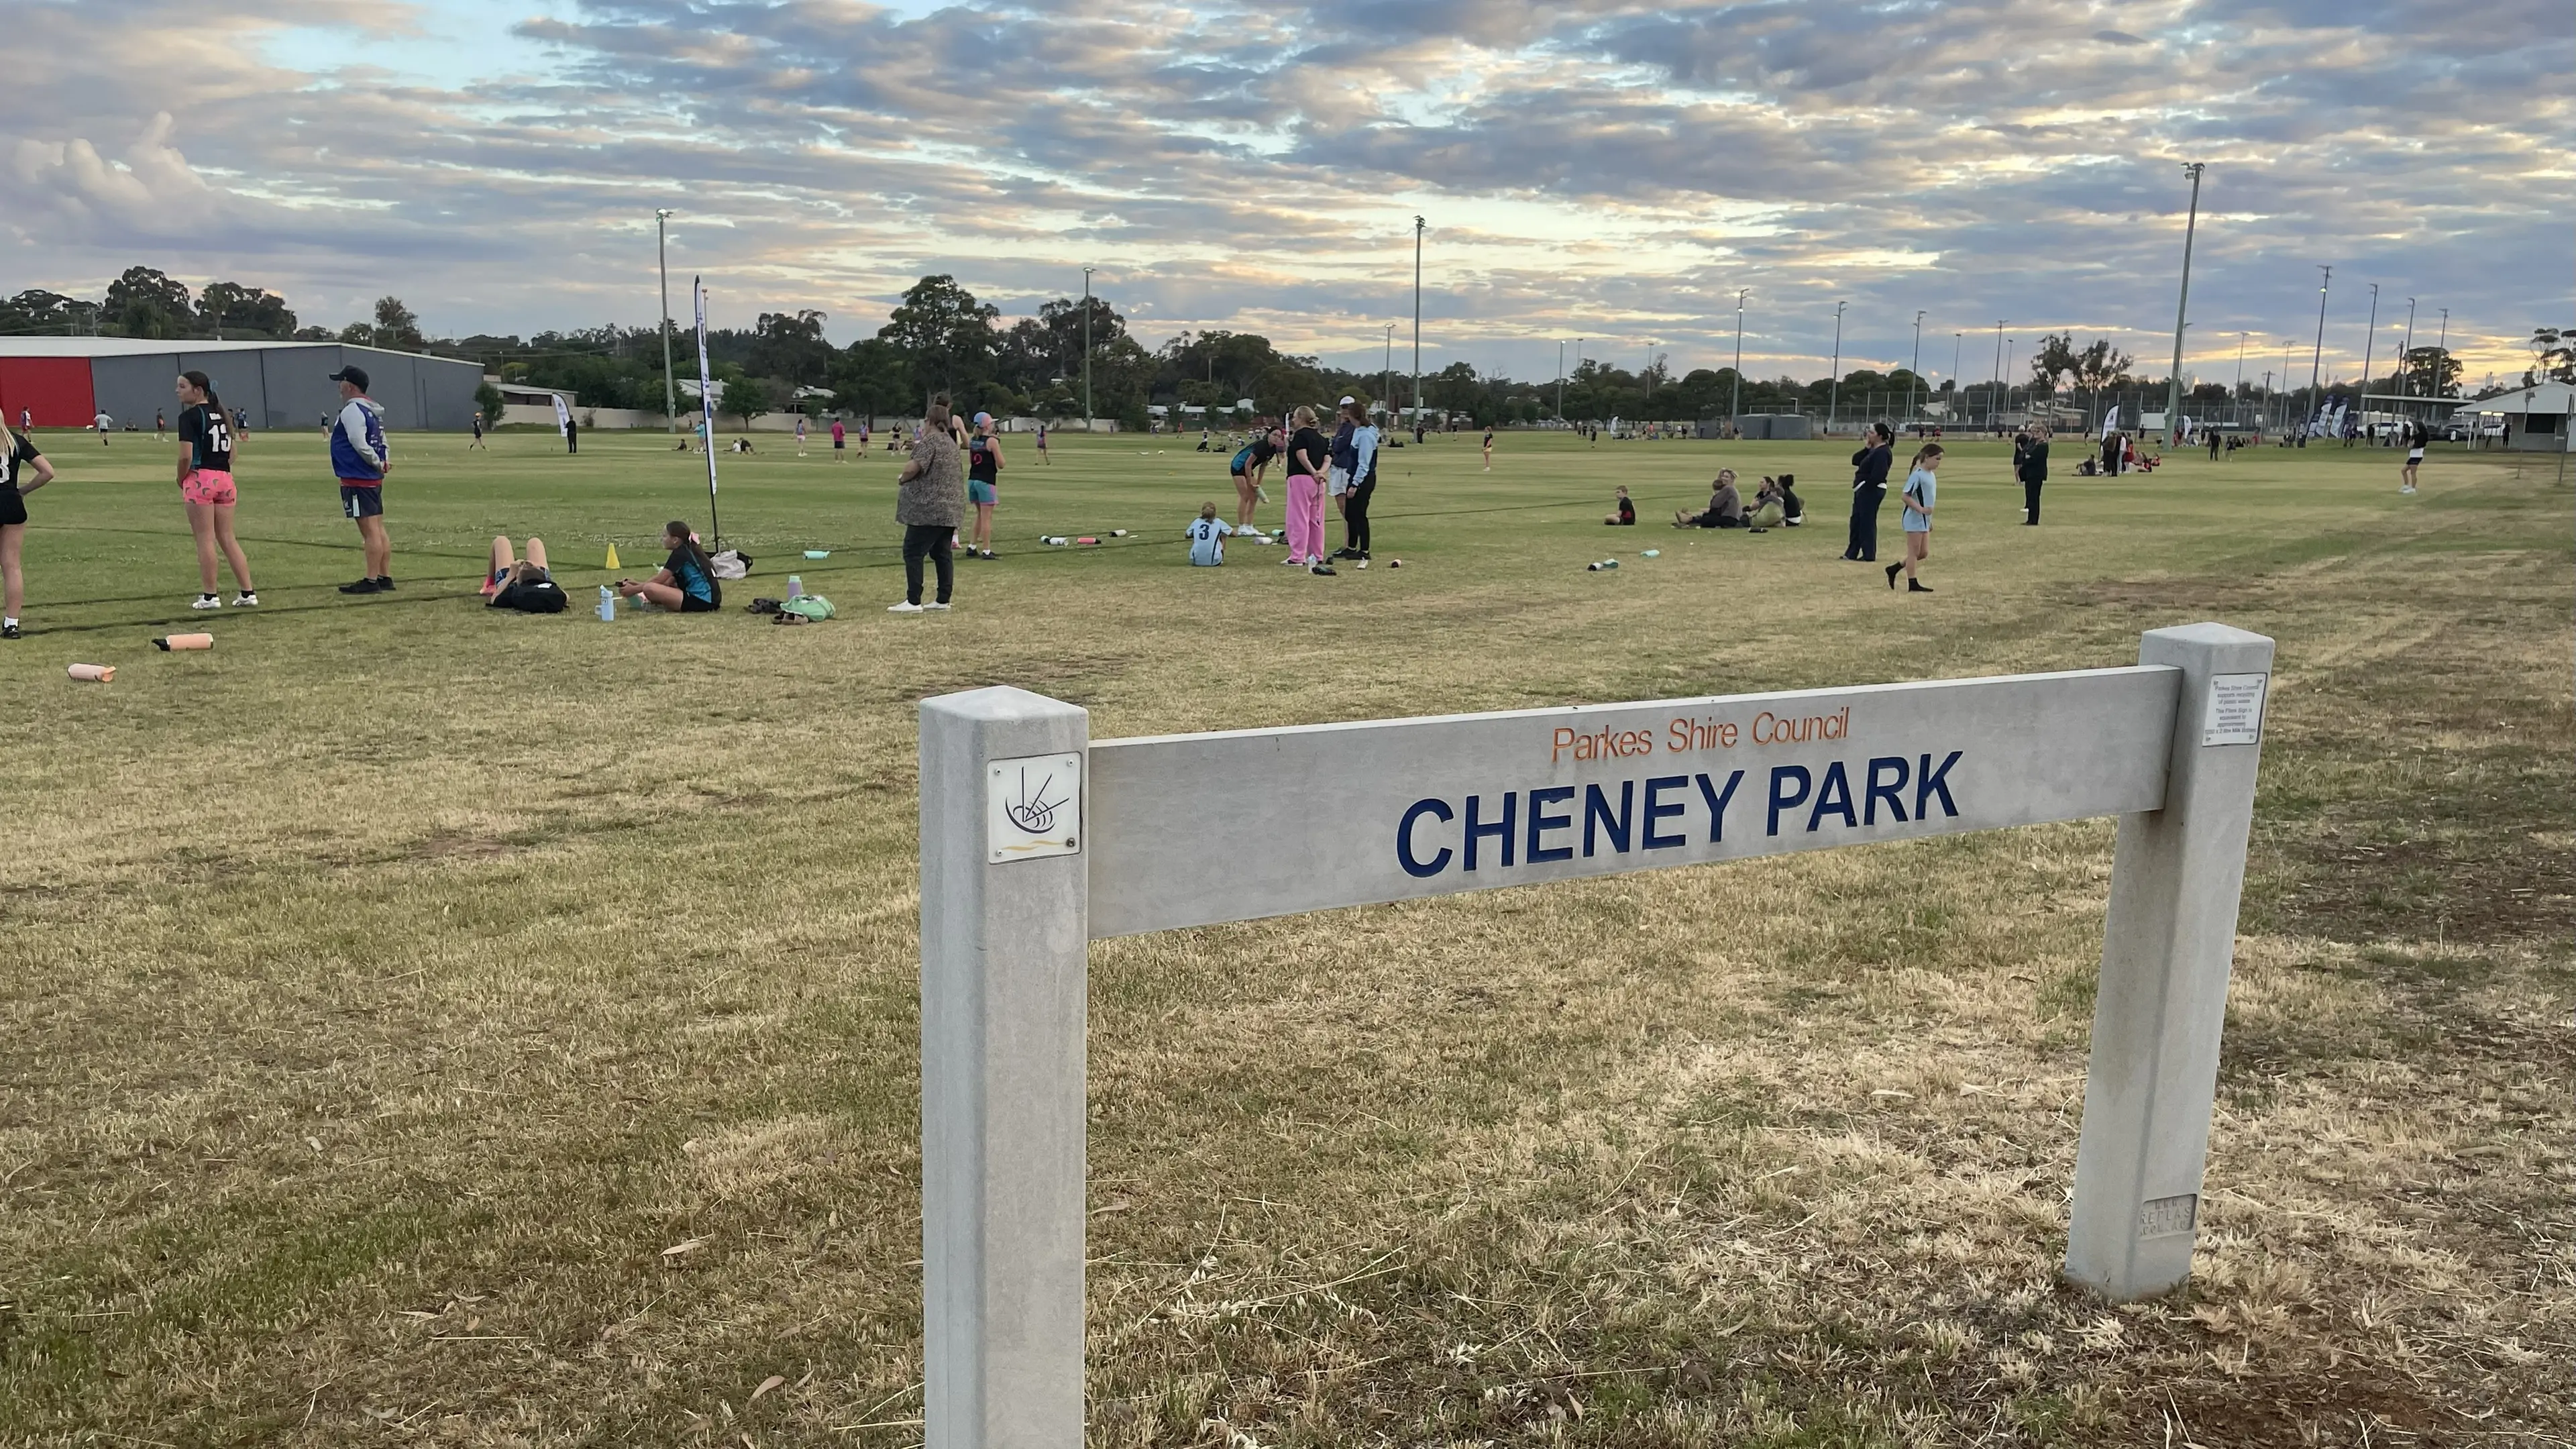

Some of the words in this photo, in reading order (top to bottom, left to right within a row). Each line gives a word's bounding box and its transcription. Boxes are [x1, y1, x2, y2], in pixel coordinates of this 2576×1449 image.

[208, 423, 232, 452] 13
[1199, 524, 1210, 541] 3
[1552, 724, 1653, 763] Parkes
[1667, 718, 1738, 753] Shire
[1751, 706, 1851, 746] Council
[1397, 770, 1746, 877] CHENEY
[1766, 751, 1964, 837] PARK
